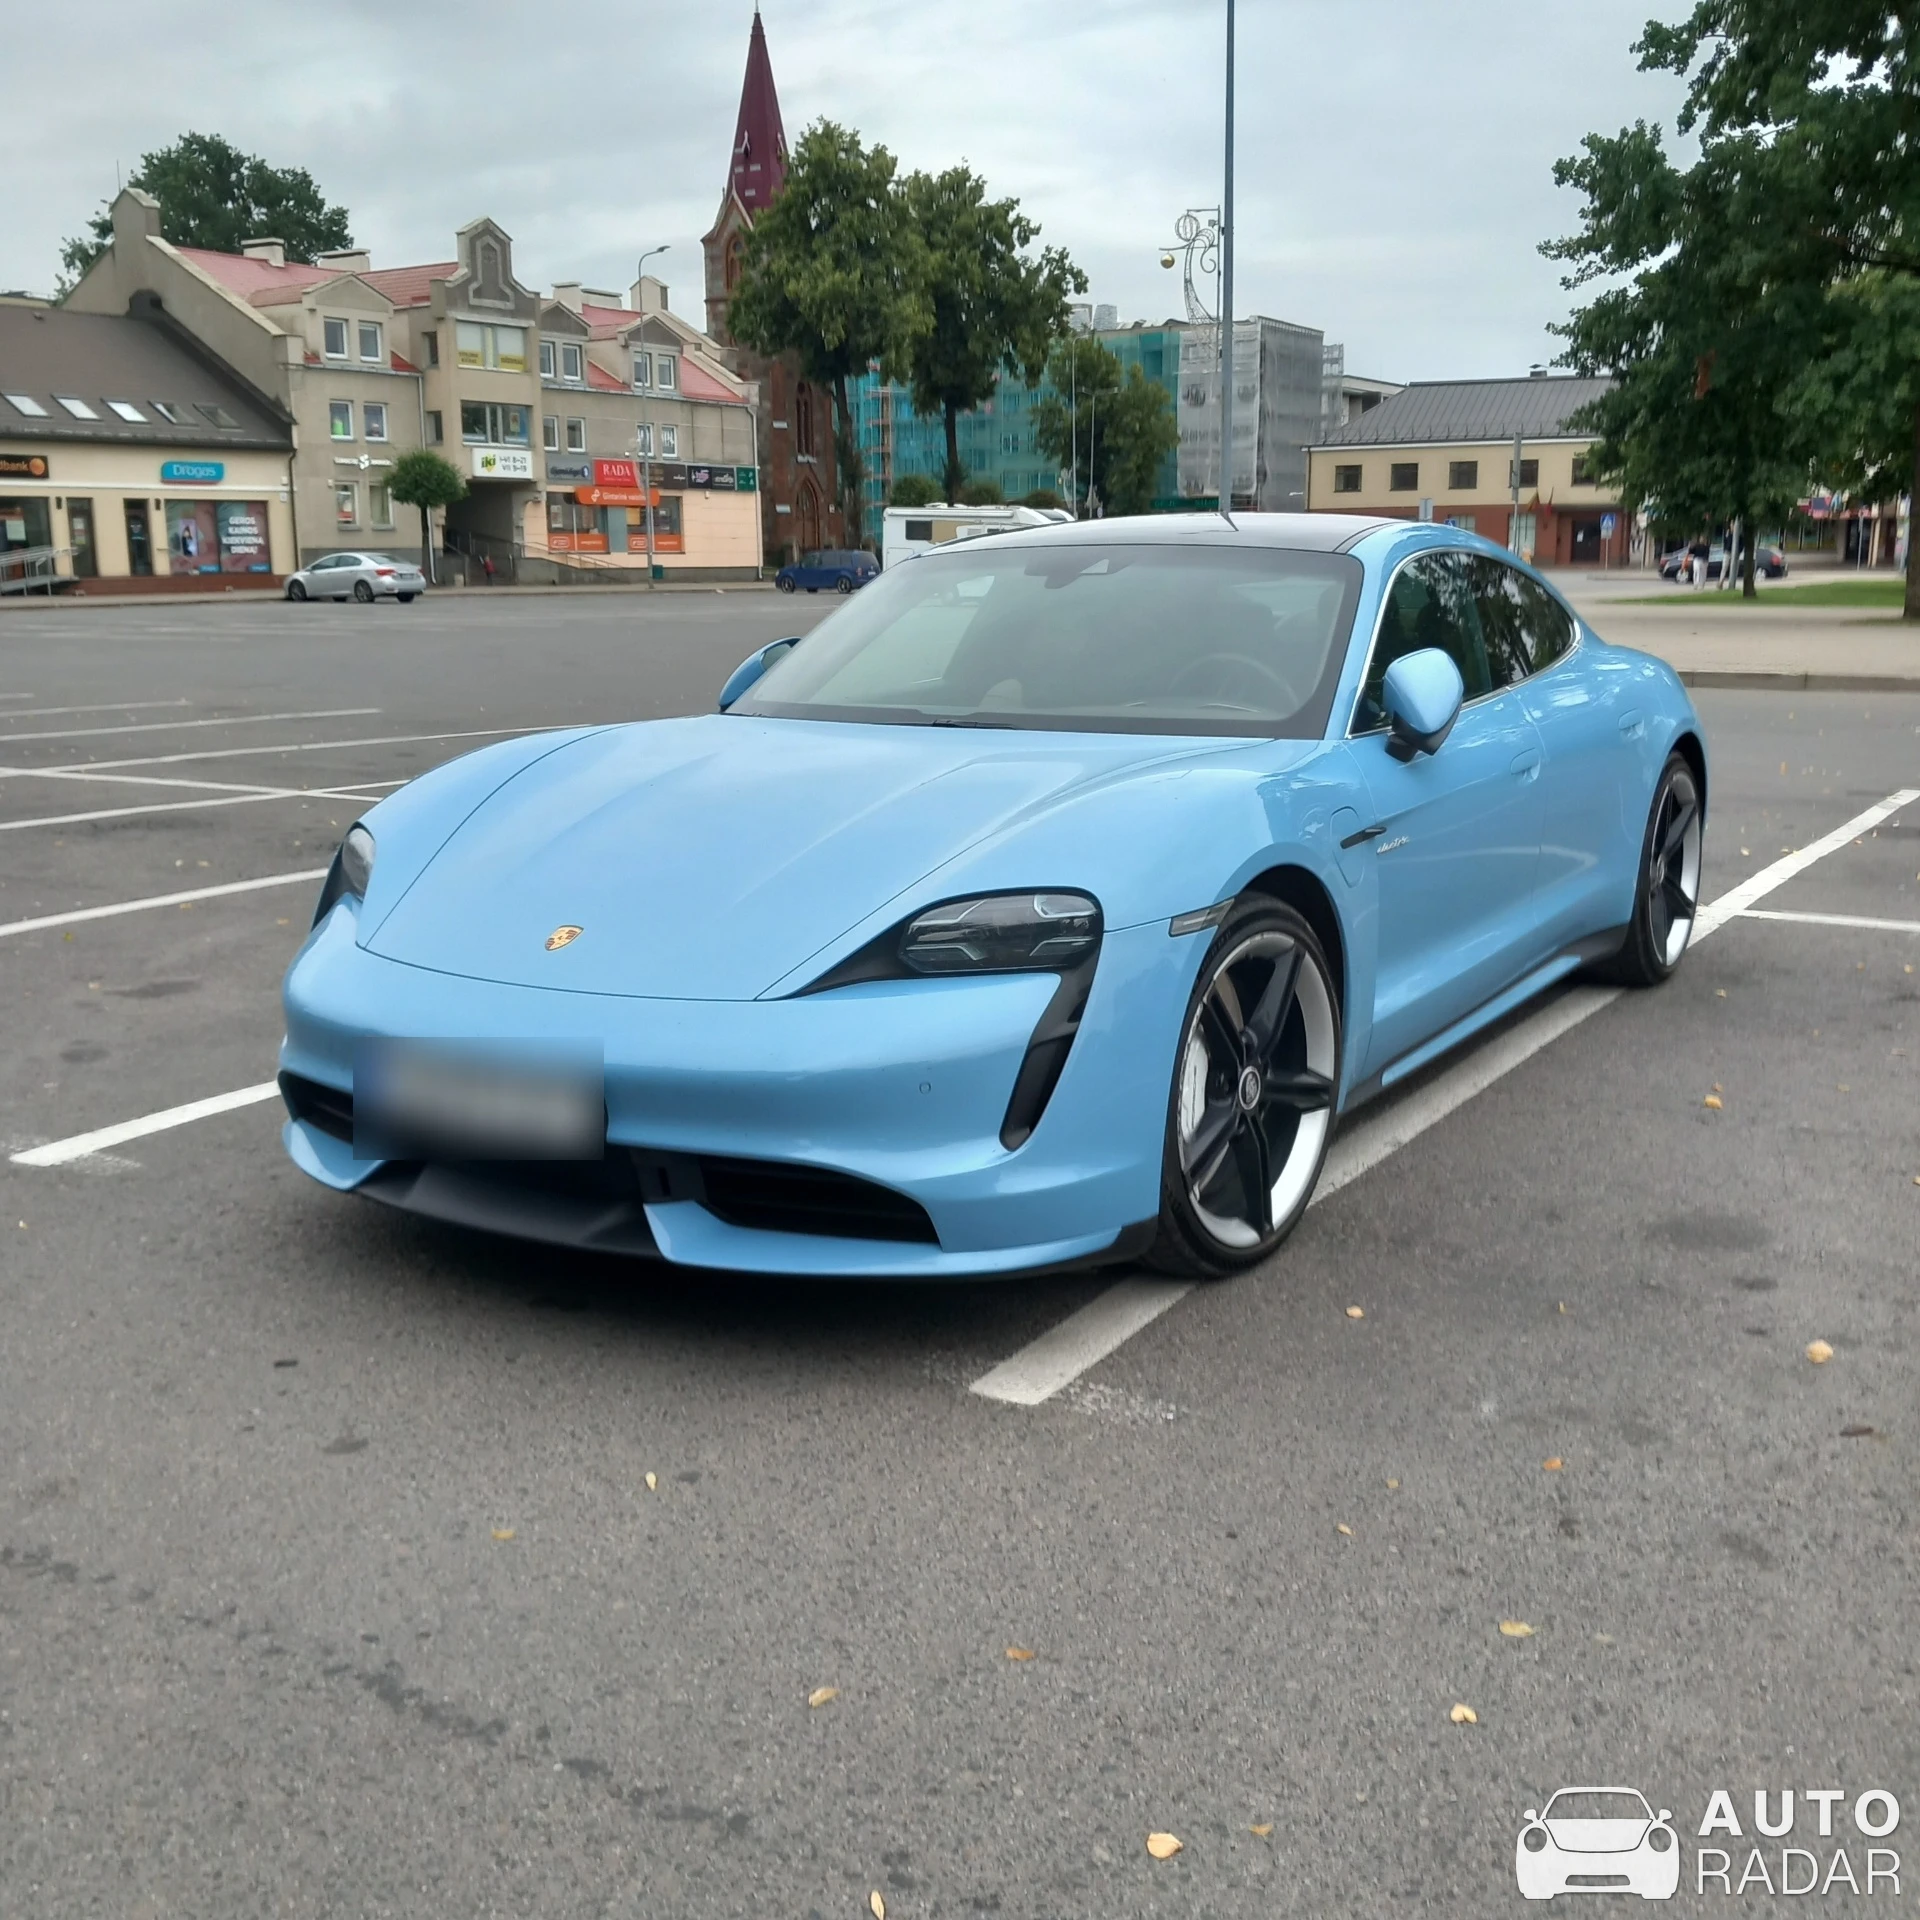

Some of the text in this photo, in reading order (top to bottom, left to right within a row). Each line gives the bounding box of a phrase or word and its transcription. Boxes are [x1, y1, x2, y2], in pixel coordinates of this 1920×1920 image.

[481, 453, 496, 469] iki
[173, 463, 217, 479] Drogas
[602, 463, 631, 477] RADA
